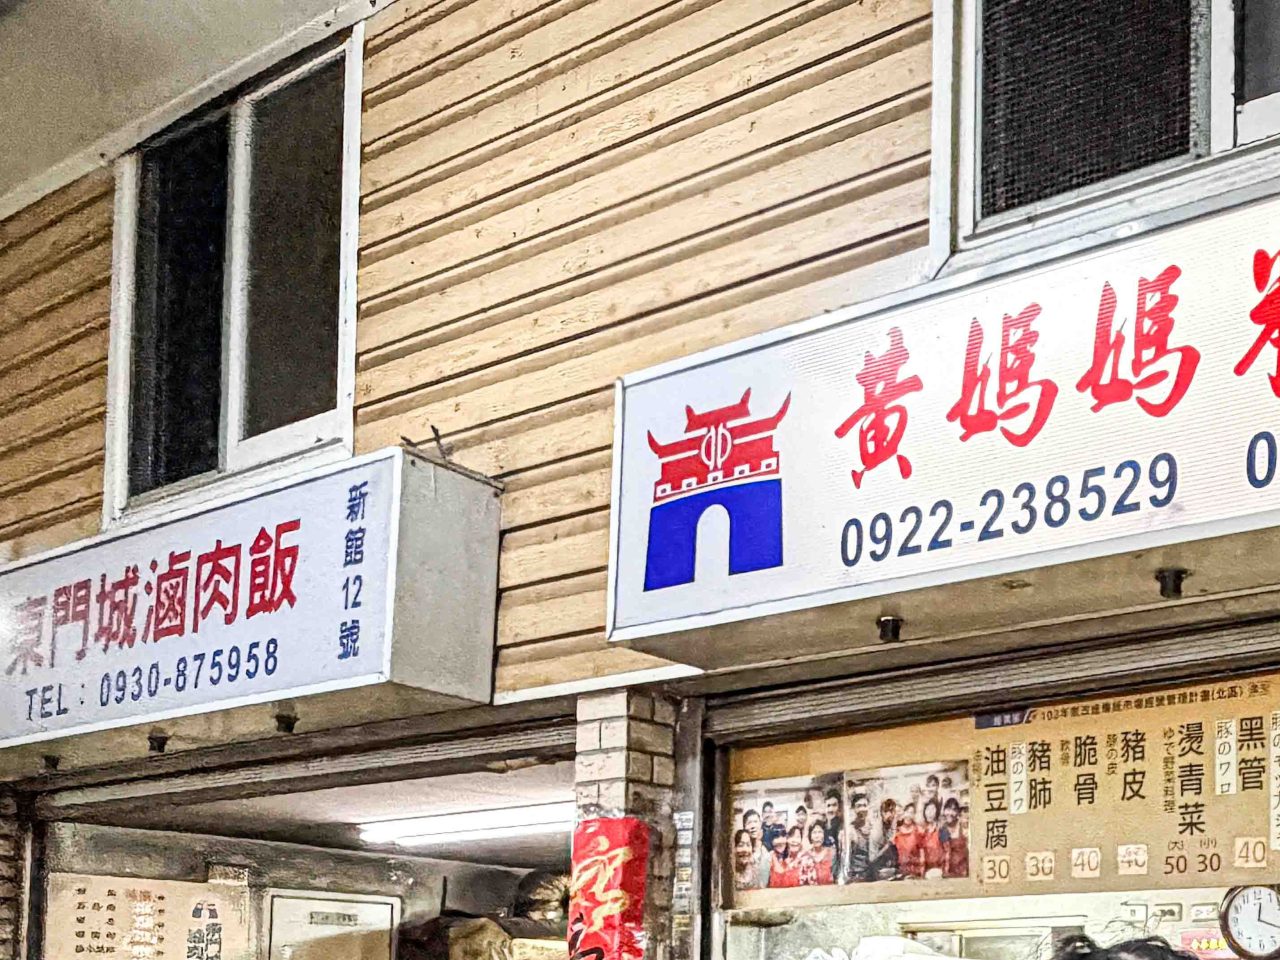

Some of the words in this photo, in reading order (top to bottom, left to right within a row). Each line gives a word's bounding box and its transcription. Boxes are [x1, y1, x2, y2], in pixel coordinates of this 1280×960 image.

[840, 452, 1178, 567] 0922-238529
[5, 518, 301, 676] 東門城滷肉飯
[337, 480, 370, 660] 新館12號
[99, 637, 279, 707] 0930-875958
[1028, 739, 1053, 810] 豬肺
[1073, 734, 1099, 806] 脆骨
[1120, 728, 1147, 801] 豬皮
[1177, 721, 1206, 836] 燙青菜
[1237, 716, 1267, 792] 黑管
[983, 744, 1009, 850] 油豆腐
[986, 858, 1010, 880] 30
[1029, 856, 1054, 878] 30
[1073, 850, 1099, 873] 40
[1163, 854, 1188, 875] 50
[1196, 852, 1221, 873] 30
[1238, 840, 1267, 864] 40
